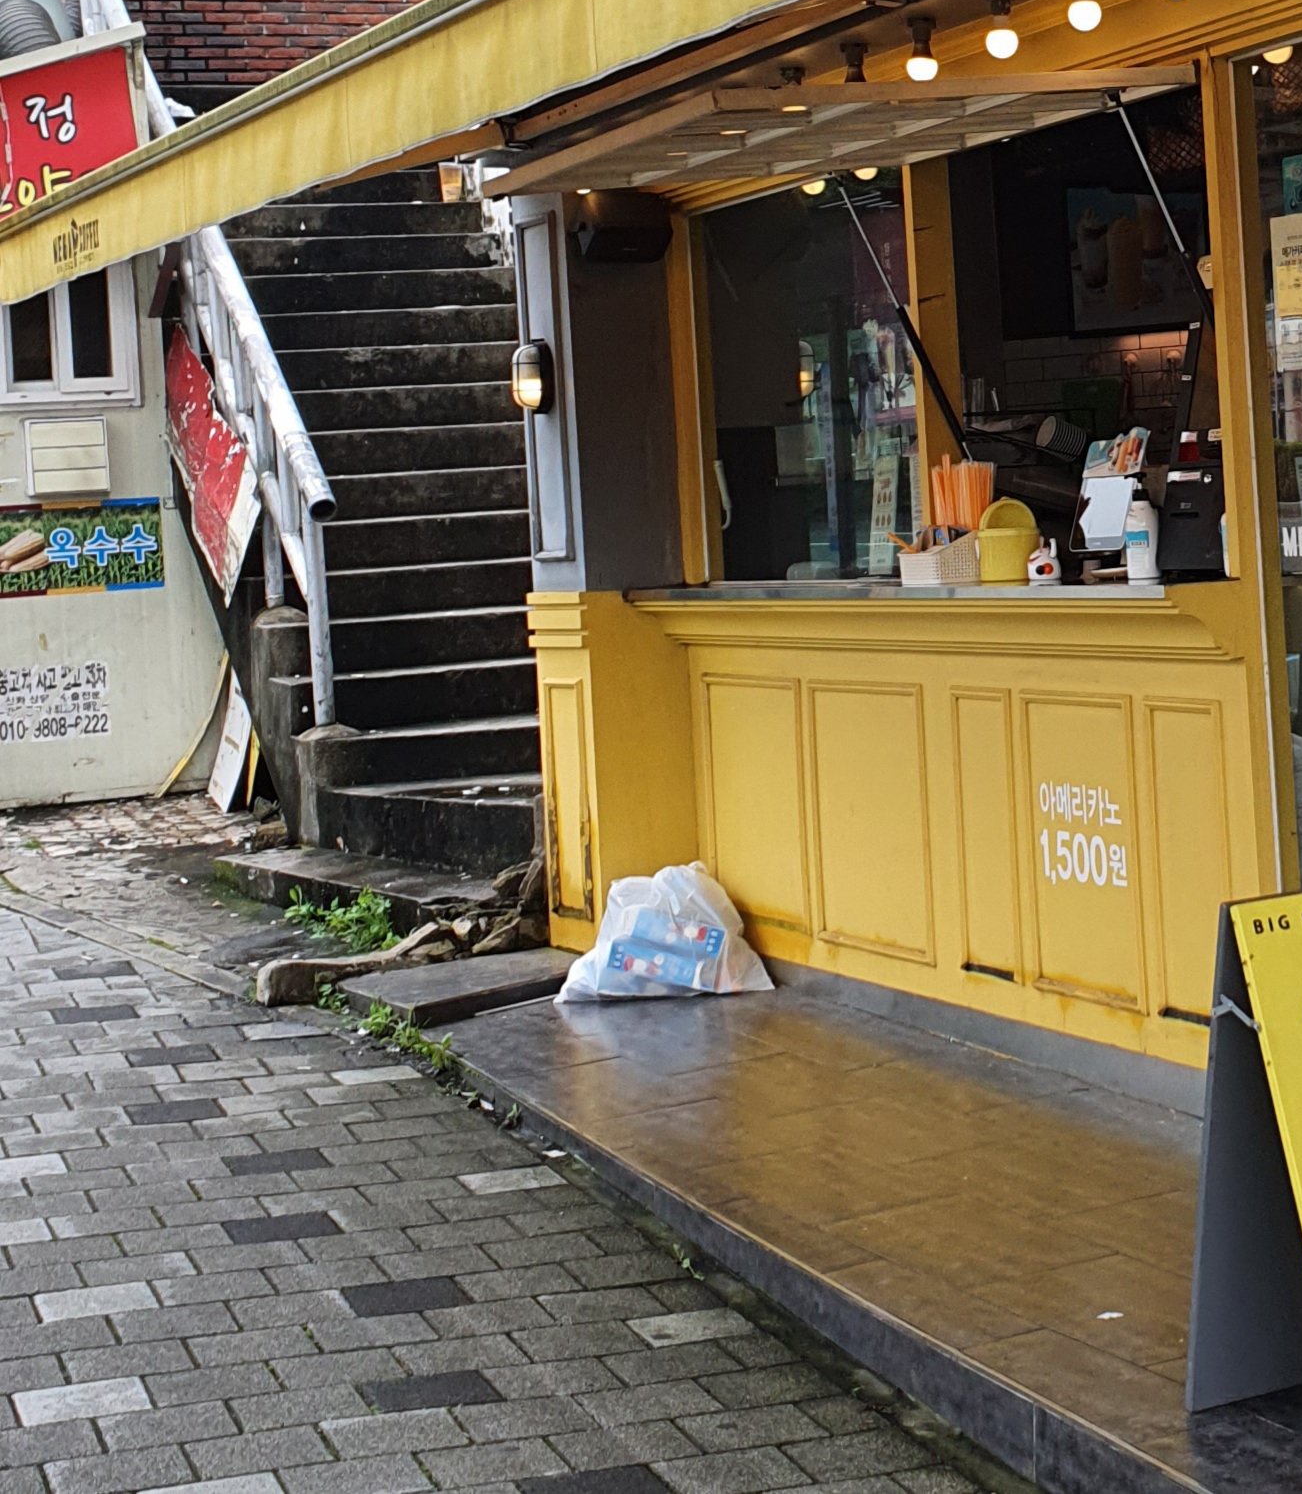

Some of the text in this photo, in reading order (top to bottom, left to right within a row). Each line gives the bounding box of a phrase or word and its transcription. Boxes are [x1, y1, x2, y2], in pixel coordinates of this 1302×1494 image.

[44, 522, 159, 568] 옥수수
[1039, 781, 1123, 827] 아메리카노
[1039, 827, 1129, 888] 1,500원
[1252, 912, 1292, 936] BIG
